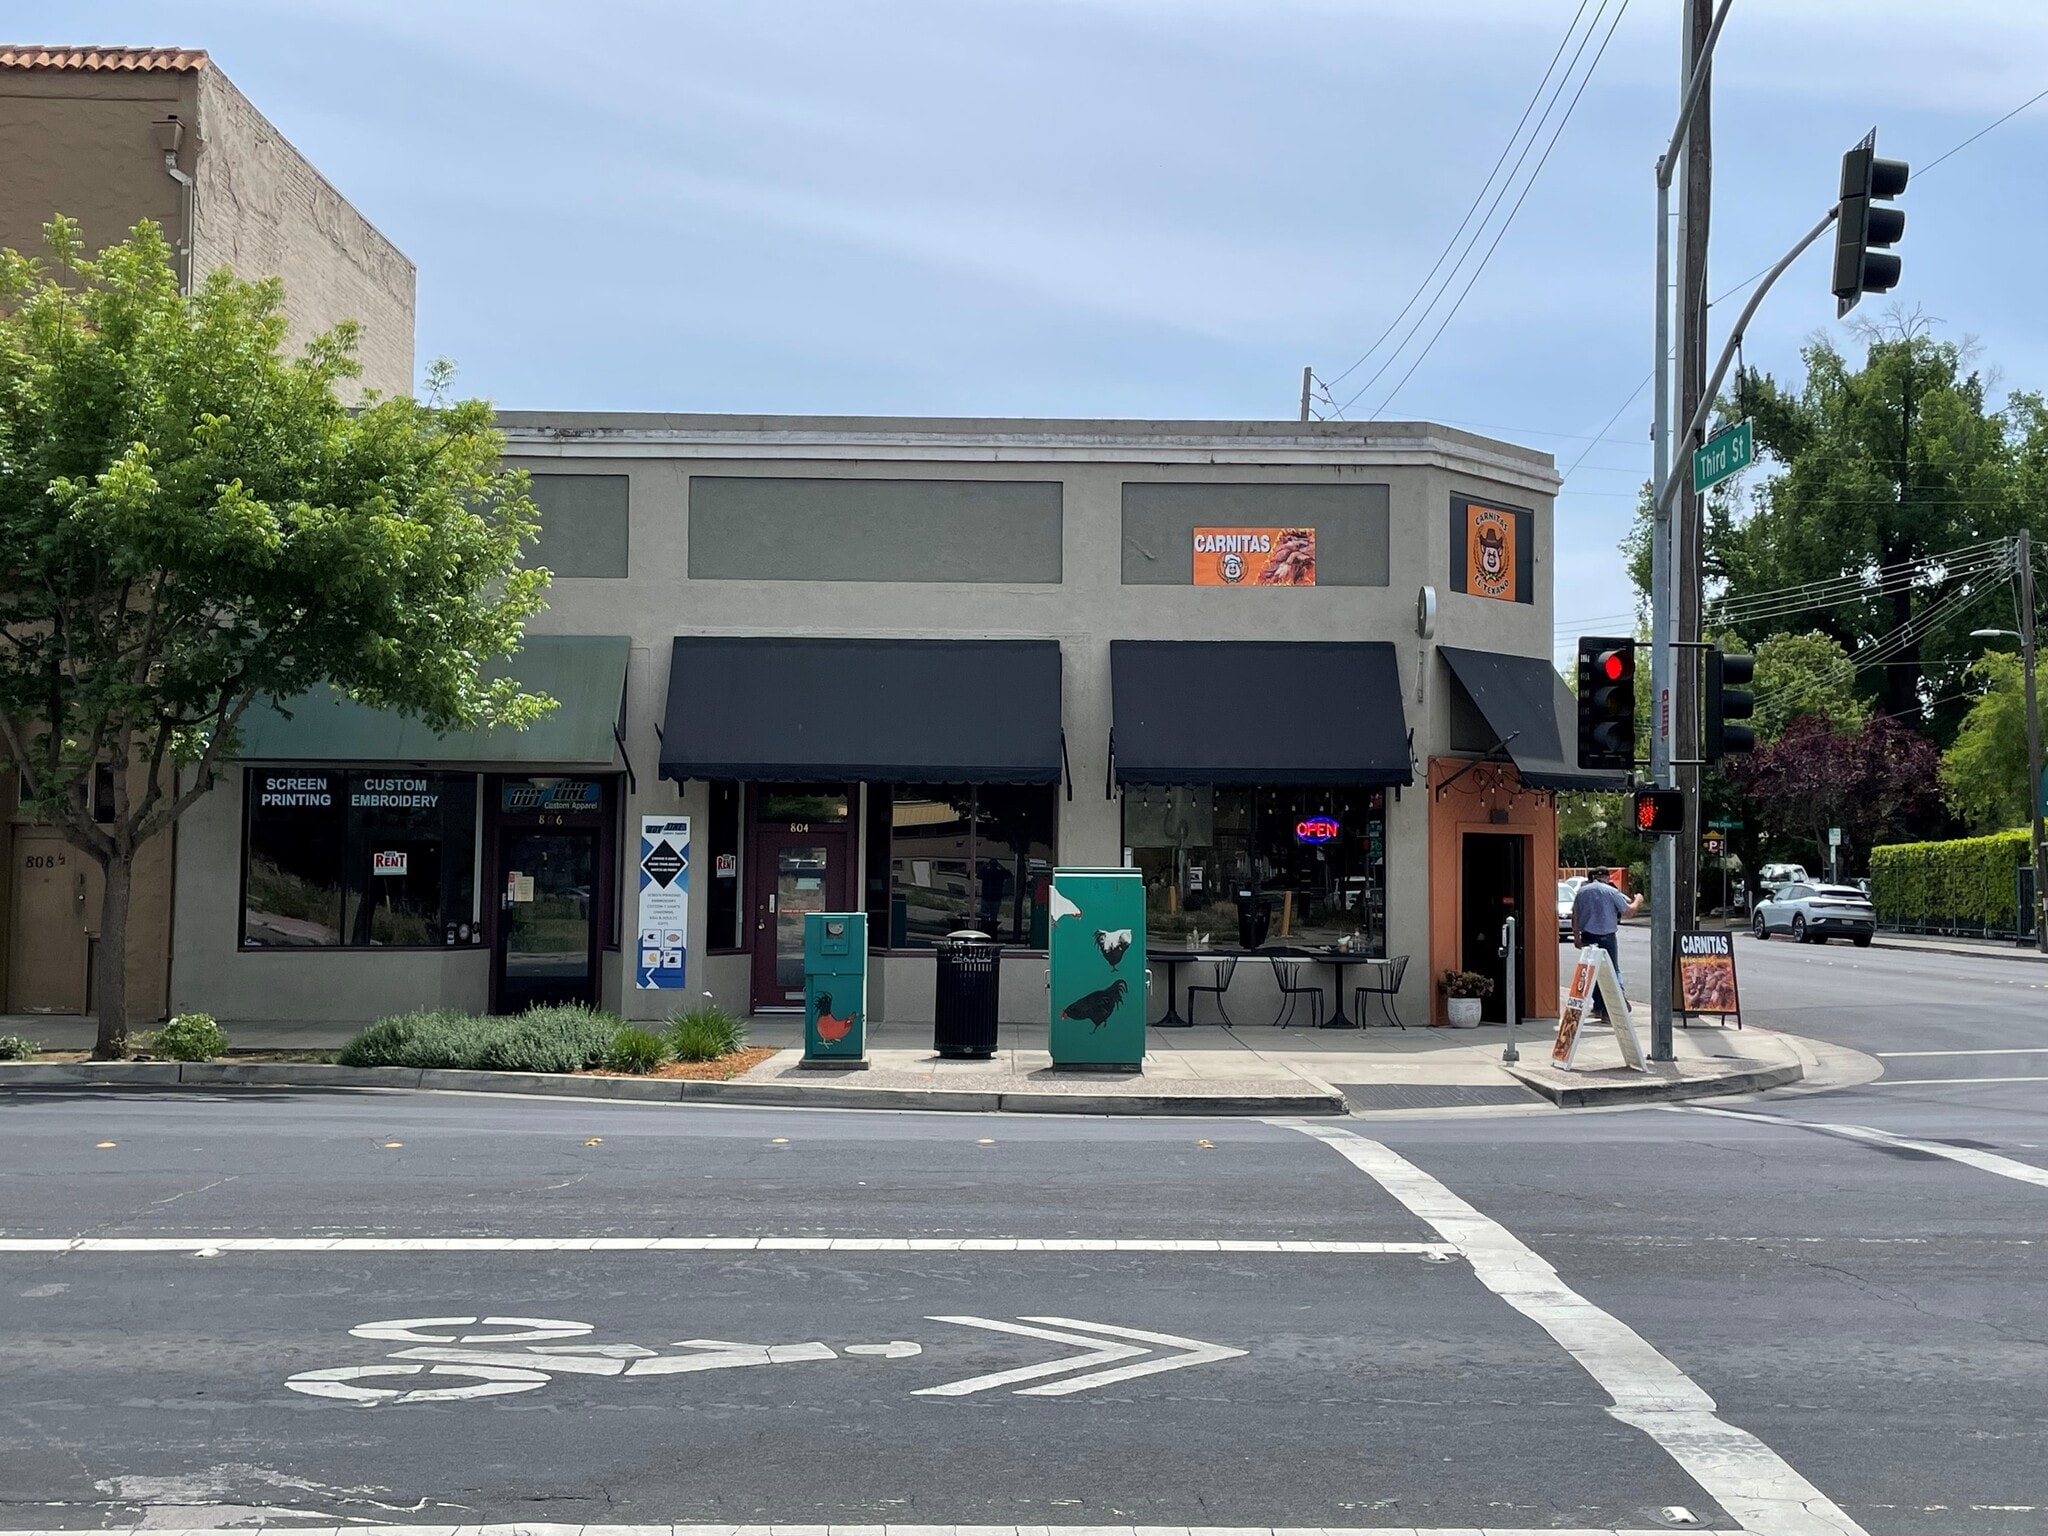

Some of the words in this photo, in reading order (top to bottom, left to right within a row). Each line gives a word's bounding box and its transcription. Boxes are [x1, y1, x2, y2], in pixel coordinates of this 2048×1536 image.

[1700, 445, 1726, 480] Third
[1732, 435, 1744, 463] St
[1475, 512, 1508, 531] CARNITAS
[1194, 534, 1272, 553] CARNITAS
[1474, 575, 1481, 586] EL
[1483, 579, 1509, 595] TEXANO
[266, 778, 327, 790] SCREEN
[364, 778, 427, 791] CUSTOM
[552, 782, 590, 801] LINE
[261, 793, 331, 806] PRINTING
[351, 794, 438, 807] EMBROIDERY
[544, 801, 570, 809] Custom
[571, 801, 598, 811] Apparel
[790, 822, 809, 833] 804
[1296, 822, 1338, 837] OPEN
[1709, 840, 1718, 850] P
[375, 853, 406, 868] RENT
[717, 857, 735, 870] RENT
[1681, 935, 1728, 955] CARNITAS
